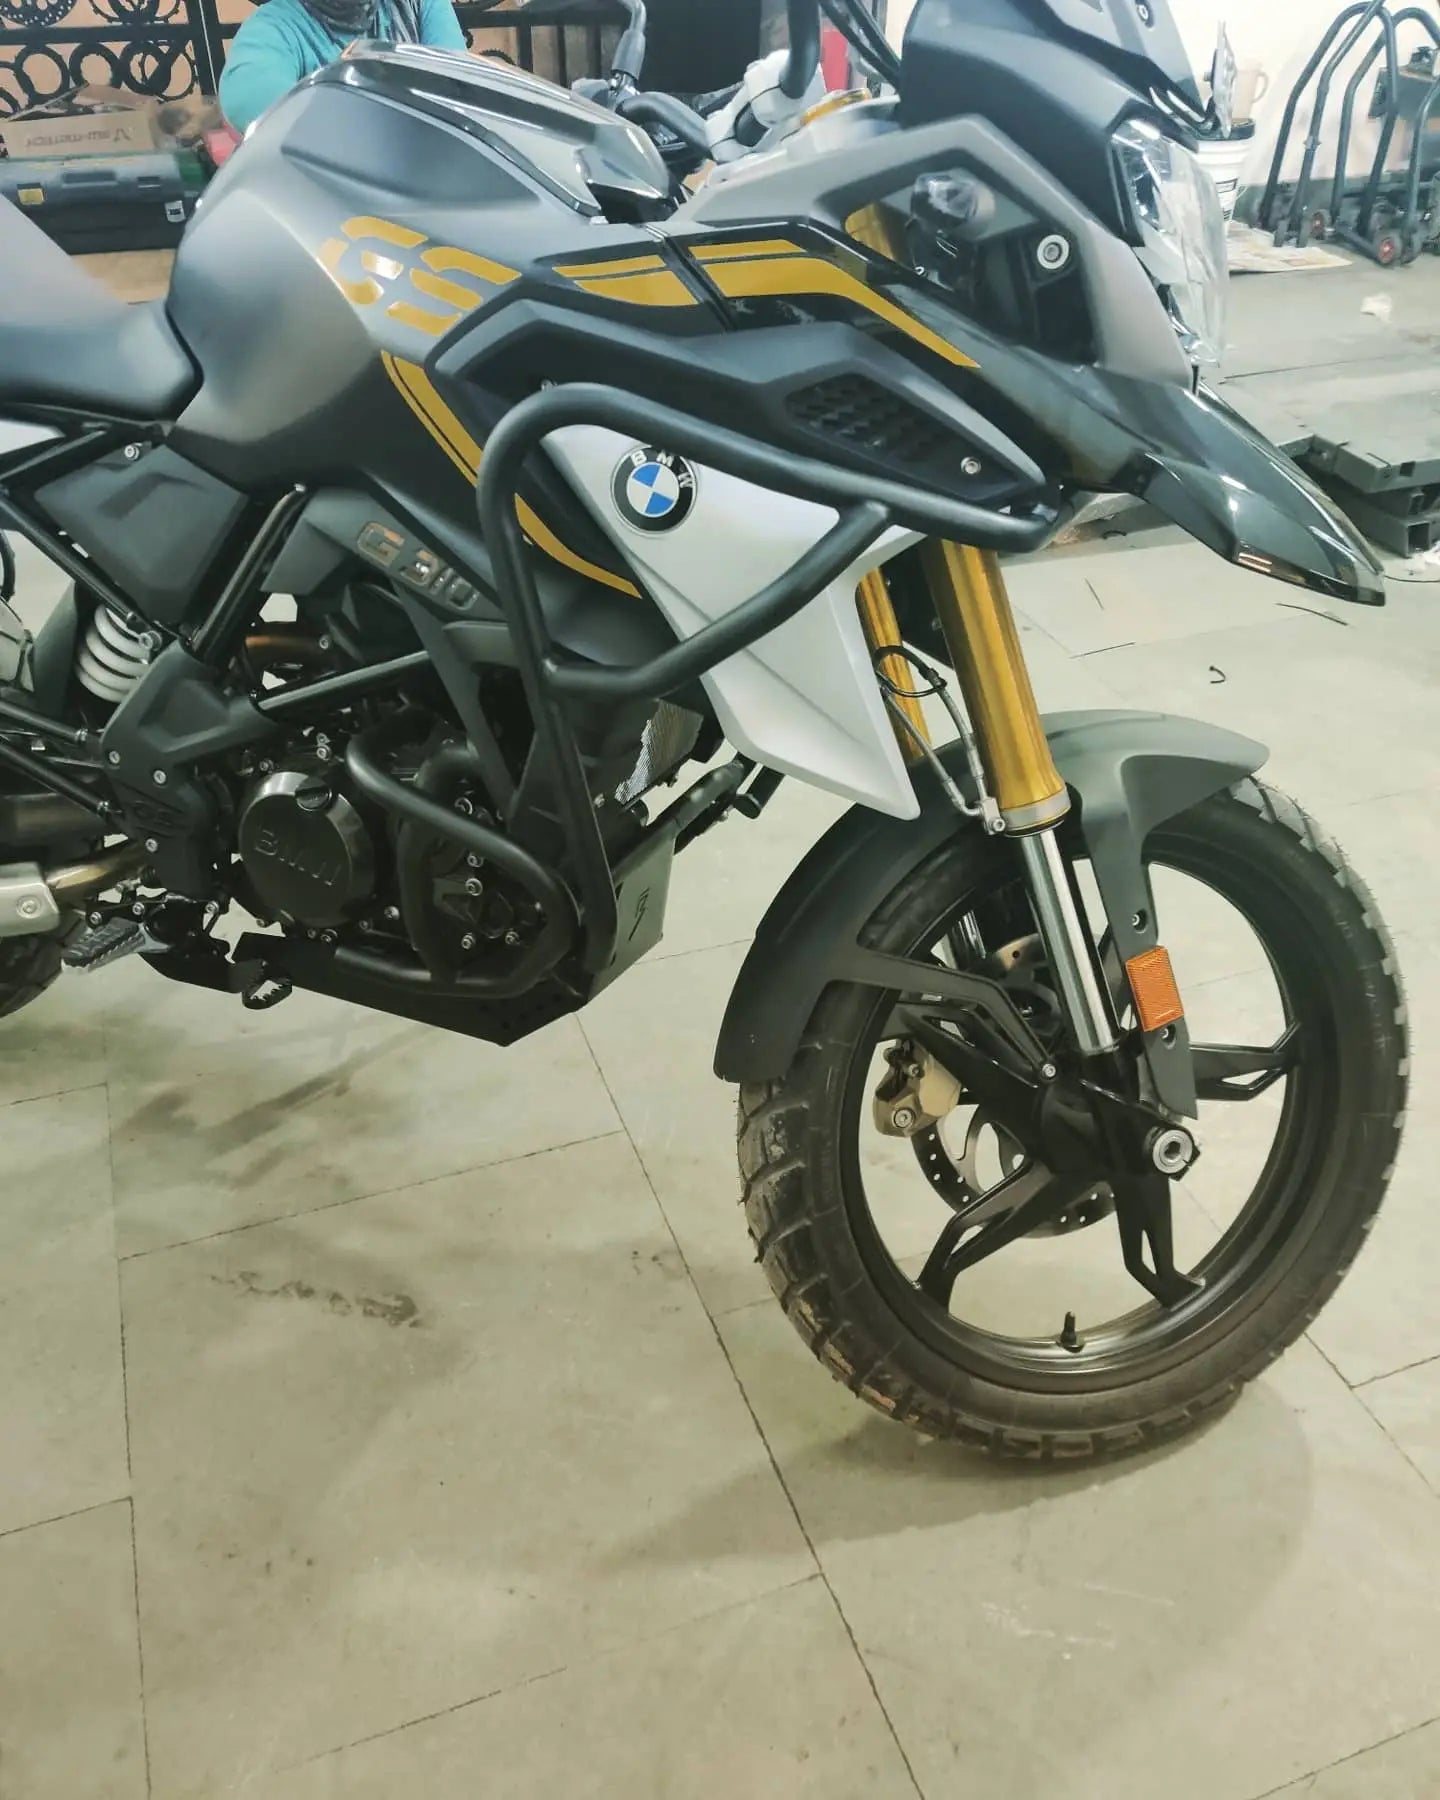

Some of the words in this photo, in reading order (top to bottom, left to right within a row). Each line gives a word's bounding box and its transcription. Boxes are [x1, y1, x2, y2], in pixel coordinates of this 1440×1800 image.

[320, 215, 523, 337] GS
[630, 449, 696, 489] BMW
[357, 522, 405, 567] G
[400, 549, 481, 611] 310
